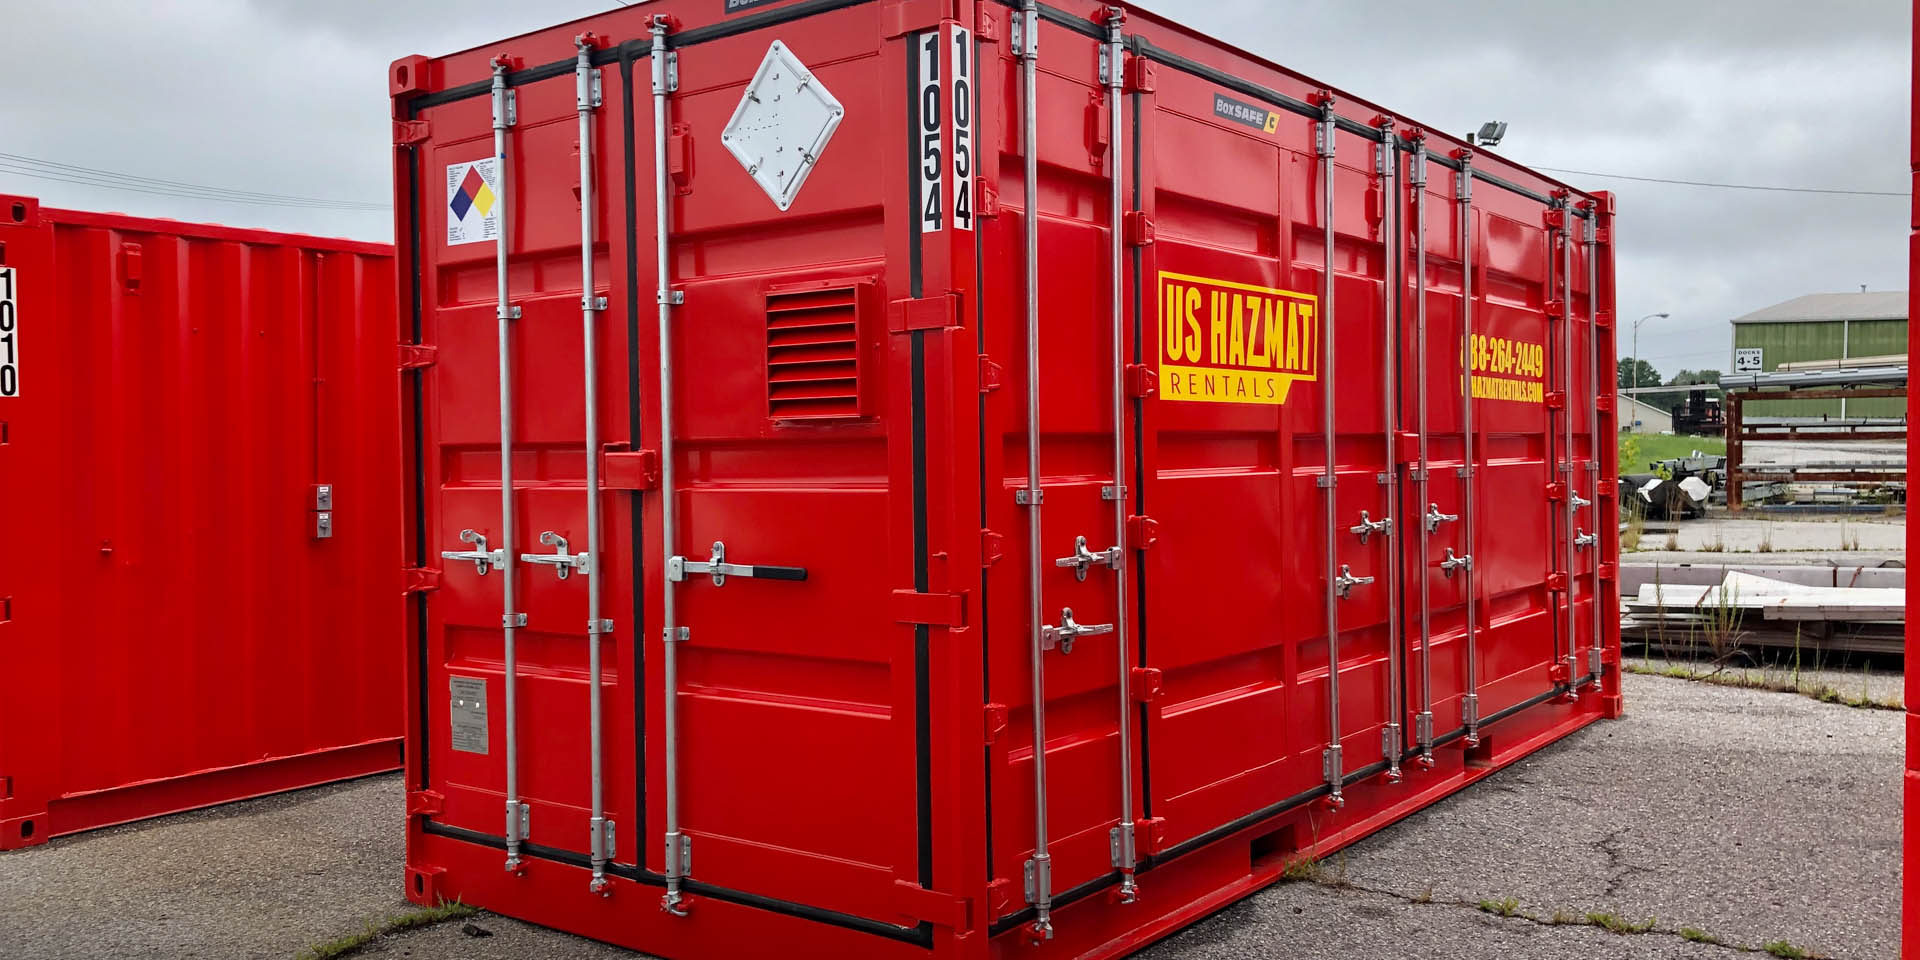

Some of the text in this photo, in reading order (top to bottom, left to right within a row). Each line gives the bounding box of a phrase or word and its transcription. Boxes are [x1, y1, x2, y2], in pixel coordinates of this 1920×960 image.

[924, 34, 942, 230] 1054
[954, 30, 971, 229] 1054
[0, 268, 16, 396] 1010
[1166, 284, 1313, 371] US HAZMAT
[1460, 333, 1543, 378] 88-264-2449
[1170, 372, 1275, 398] RENTALS
[1460, 375, 1543, 403] HAZMATRENTALS.COM
